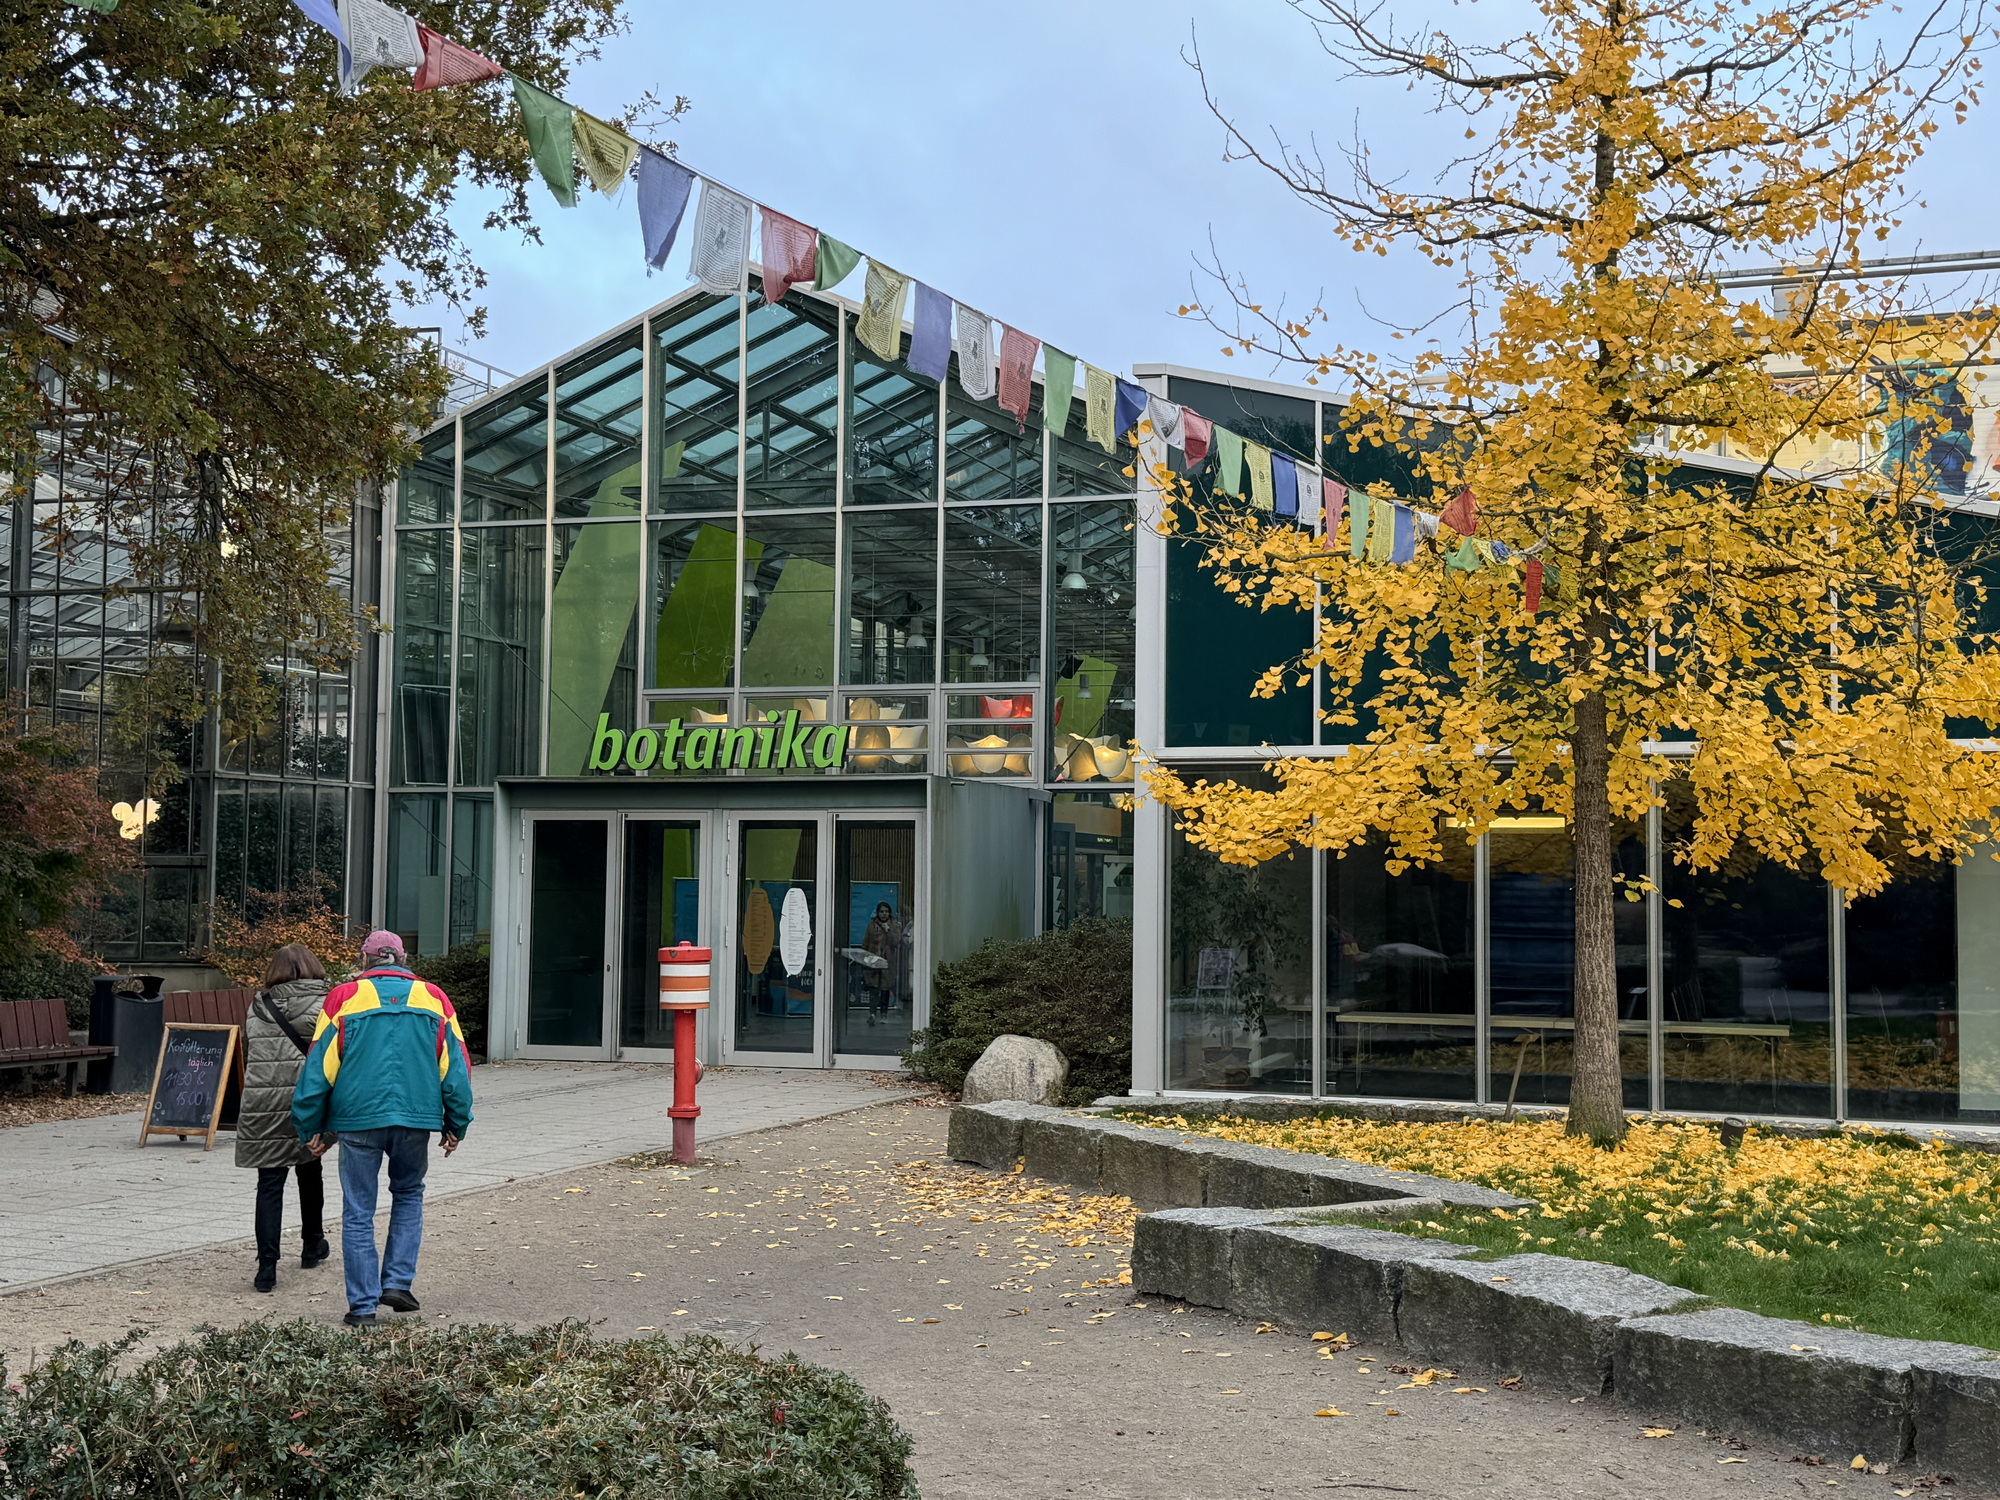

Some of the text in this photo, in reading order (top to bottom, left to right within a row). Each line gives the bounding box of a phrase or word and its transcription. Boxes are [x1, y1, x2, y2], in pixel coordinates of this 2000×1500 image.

[588, 709, 851, 771] botanika
[167, 1037, 222, 1058] Koifütterung
[188, 1055, 213, 1072] täglich
